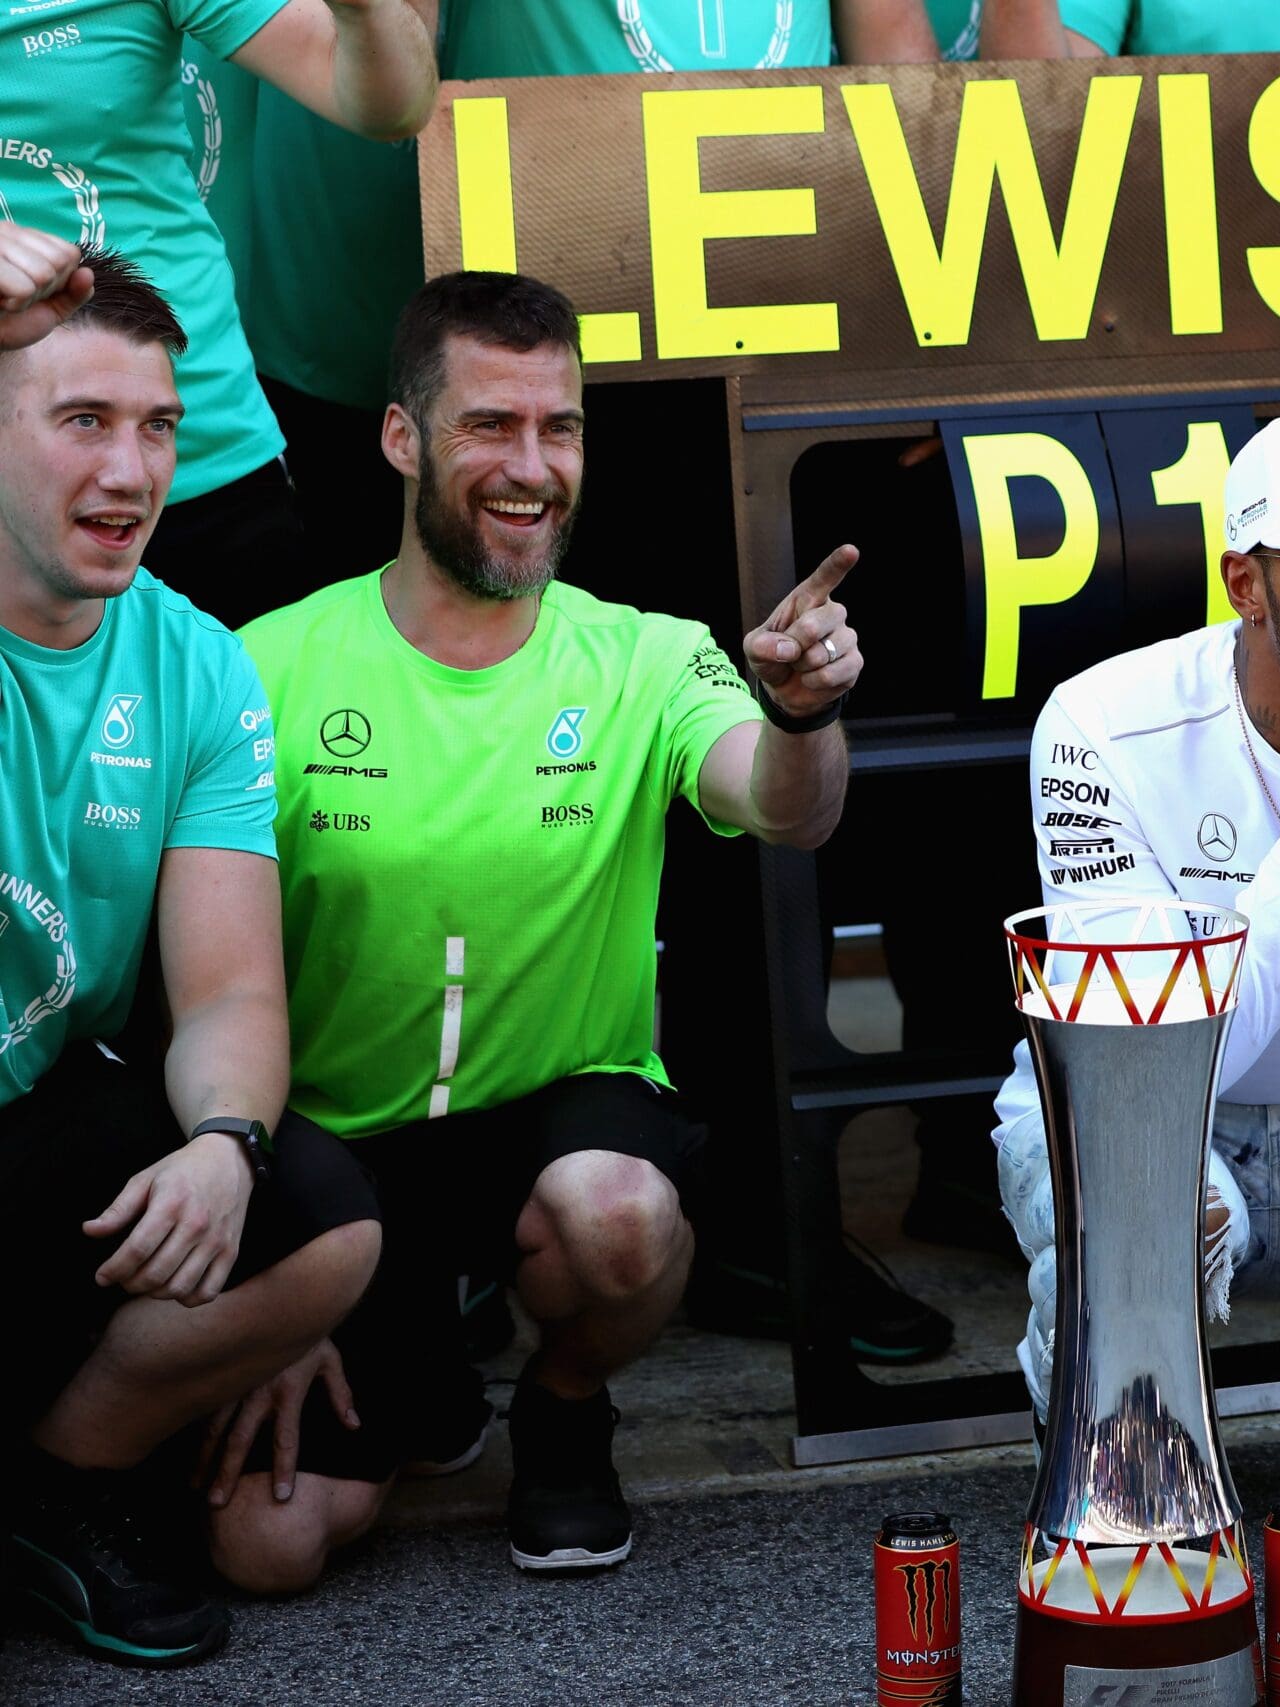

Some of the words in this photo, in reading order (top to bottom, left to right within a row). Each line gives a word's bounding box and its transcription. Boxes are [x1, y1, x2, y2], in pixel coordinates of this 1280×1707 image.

[22, 23, 80, 53] BOSS
[962, 420, 1232, 700] P1
[90, 751, 152, 769] PETRONAS
[1051, 743, 1099, 770] IWC
[327, 765, 388, 778] AMG
[536, 760, 597, 776] PETRONAS
[1041, 777, 1110, 807] EPSON
[85, 801, 141, 824] BOSS
[541, 803, 594, 823] BOSS
[1041, 812, 1122, 830] BOSE
[333, 813, 371, 832] UBS
[1068, 853, 1136, 883] WIHURI
[1201, 869, 1256, 883] AMG
[0, 870, 68, 943] INNERS
[890, 1538, 917, 1547] LEWIS
[1178, 1676, 1210, 1686] FORMULA
